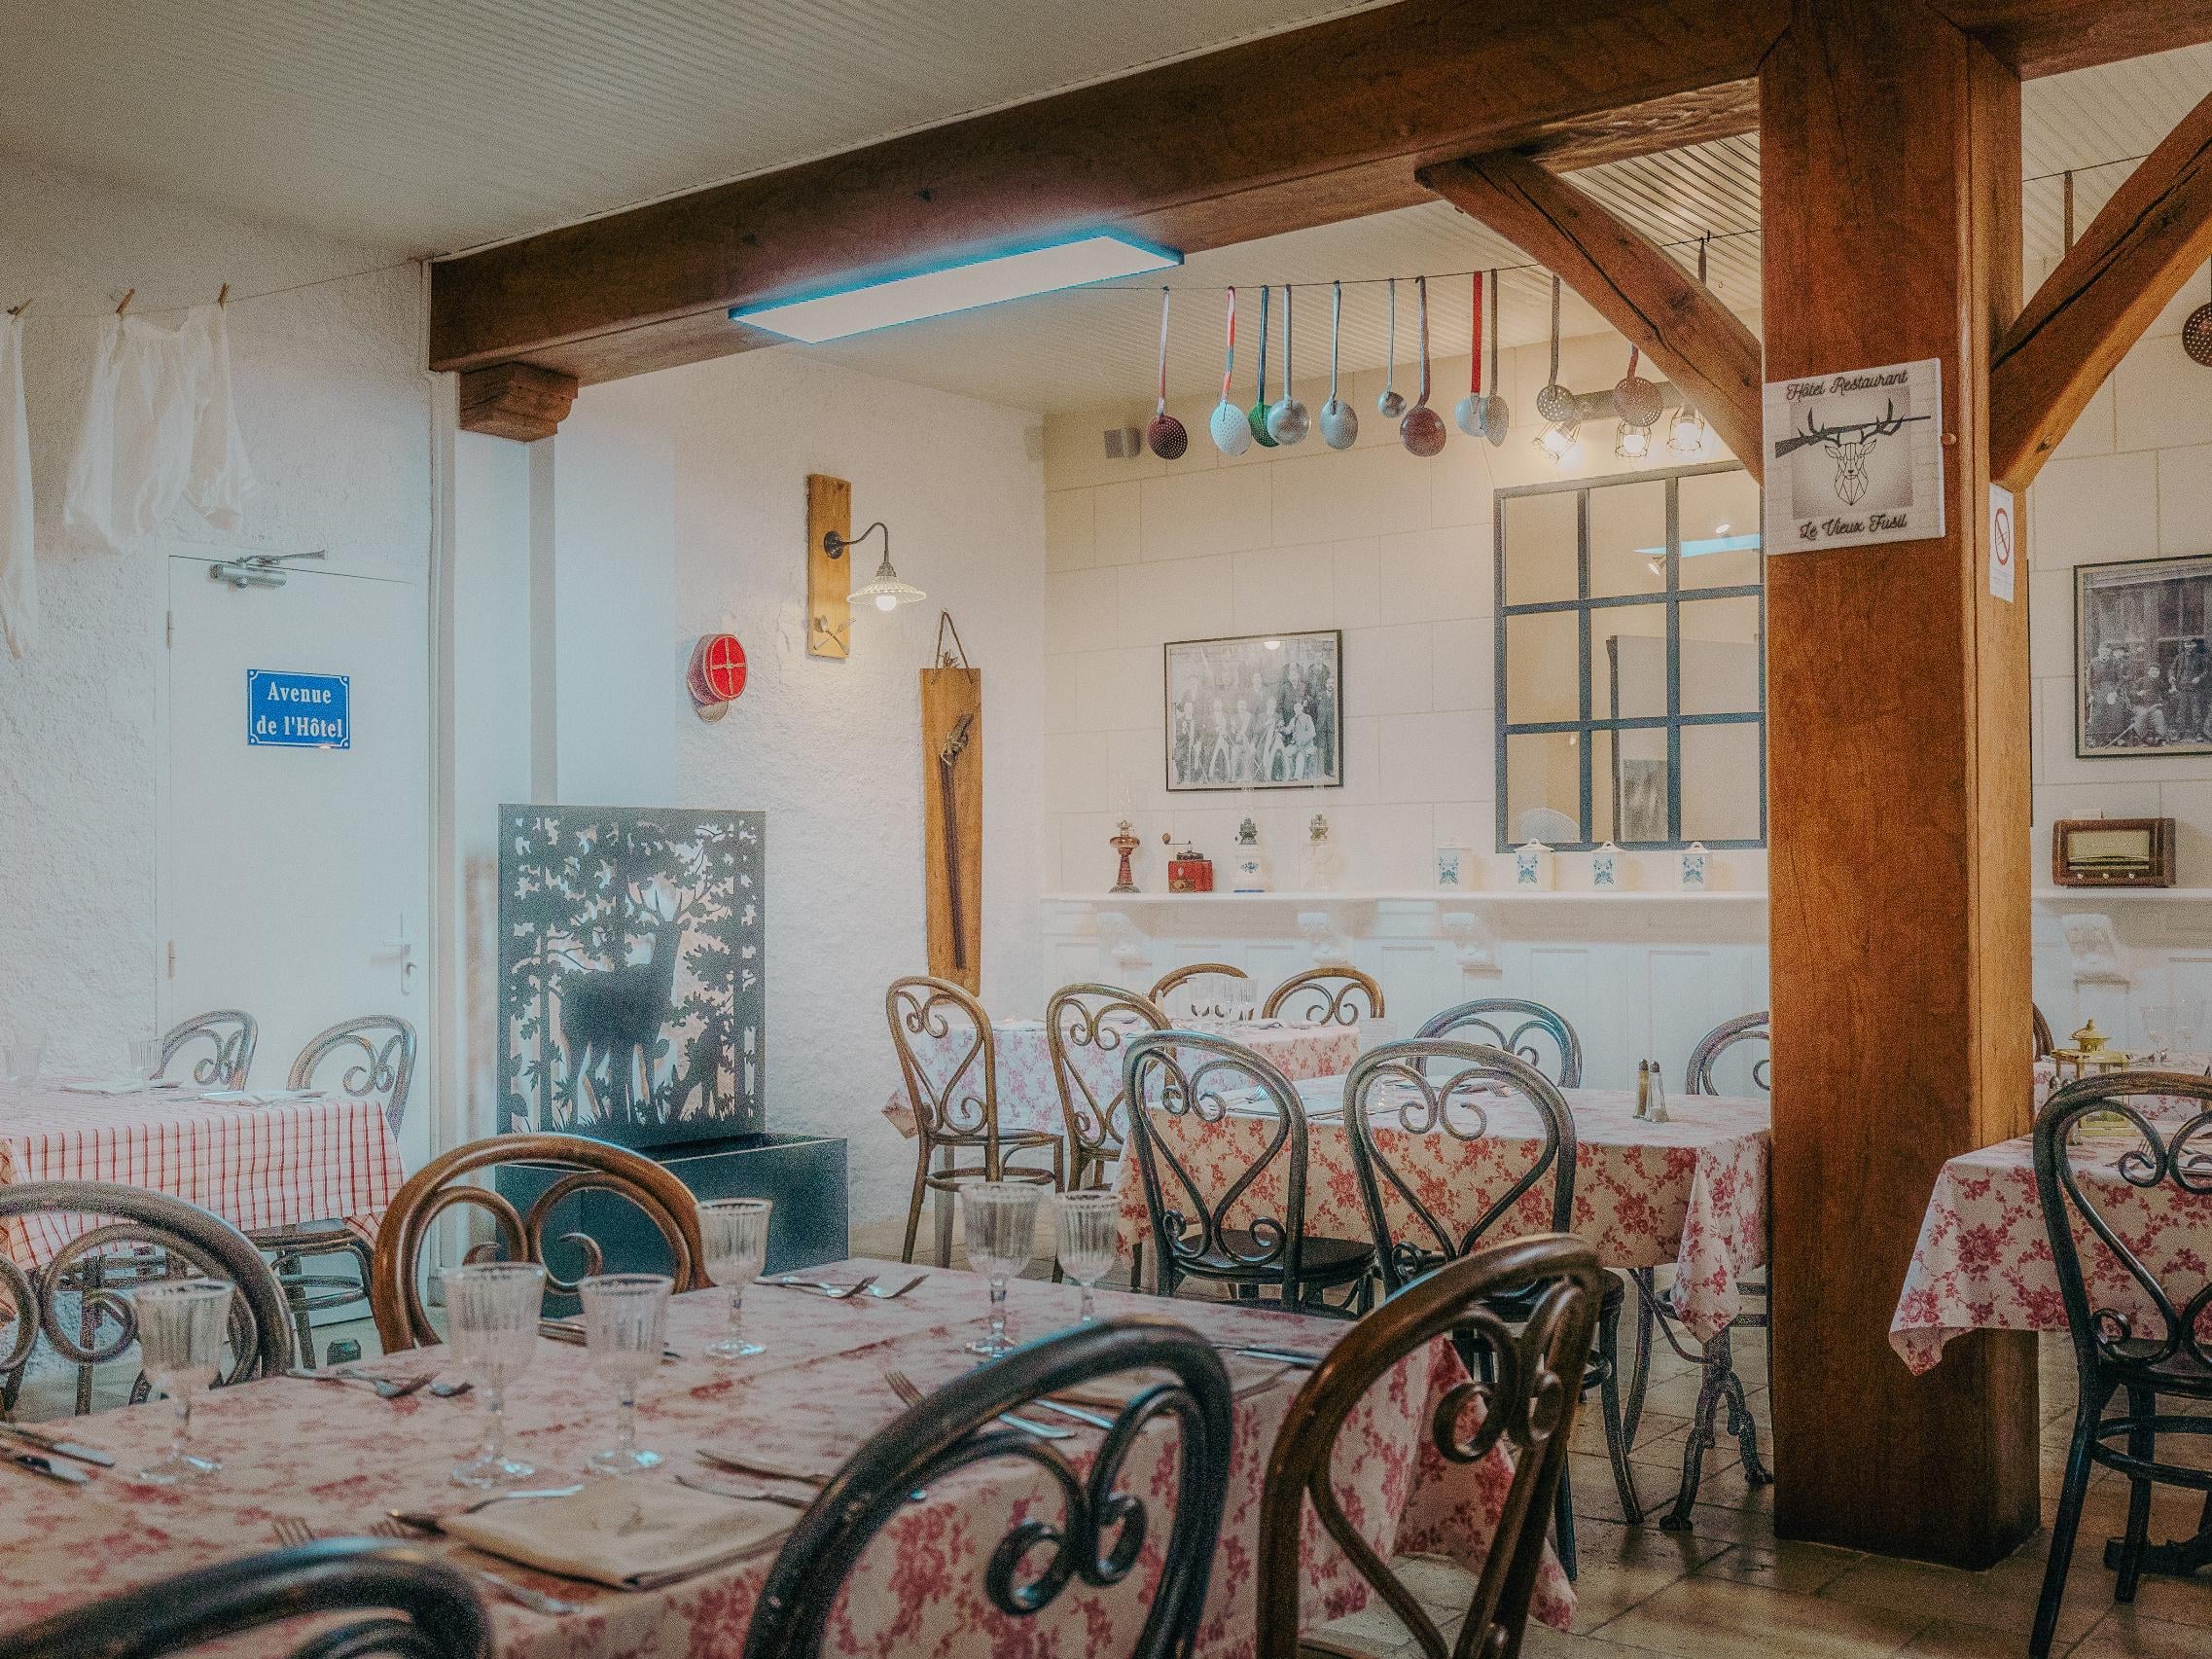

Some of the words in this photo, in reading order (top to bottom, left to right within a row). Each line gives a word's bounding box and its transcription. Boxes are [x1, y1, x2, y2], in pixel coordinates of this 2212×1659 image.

[1786, 380, 1825, 401] Hôtel
[1830, 369, 1909, 396] Restaurant
[1800, 521, 1818, 541] Le
[1822, 518, 1865, 536] Vieux
[1870, 513, 1909, 532] Fusil
[268, 681, 332, 703] Avenue
[256, 715, 277, 736] de
[284, 716, 343, 738] l'Hôtel
